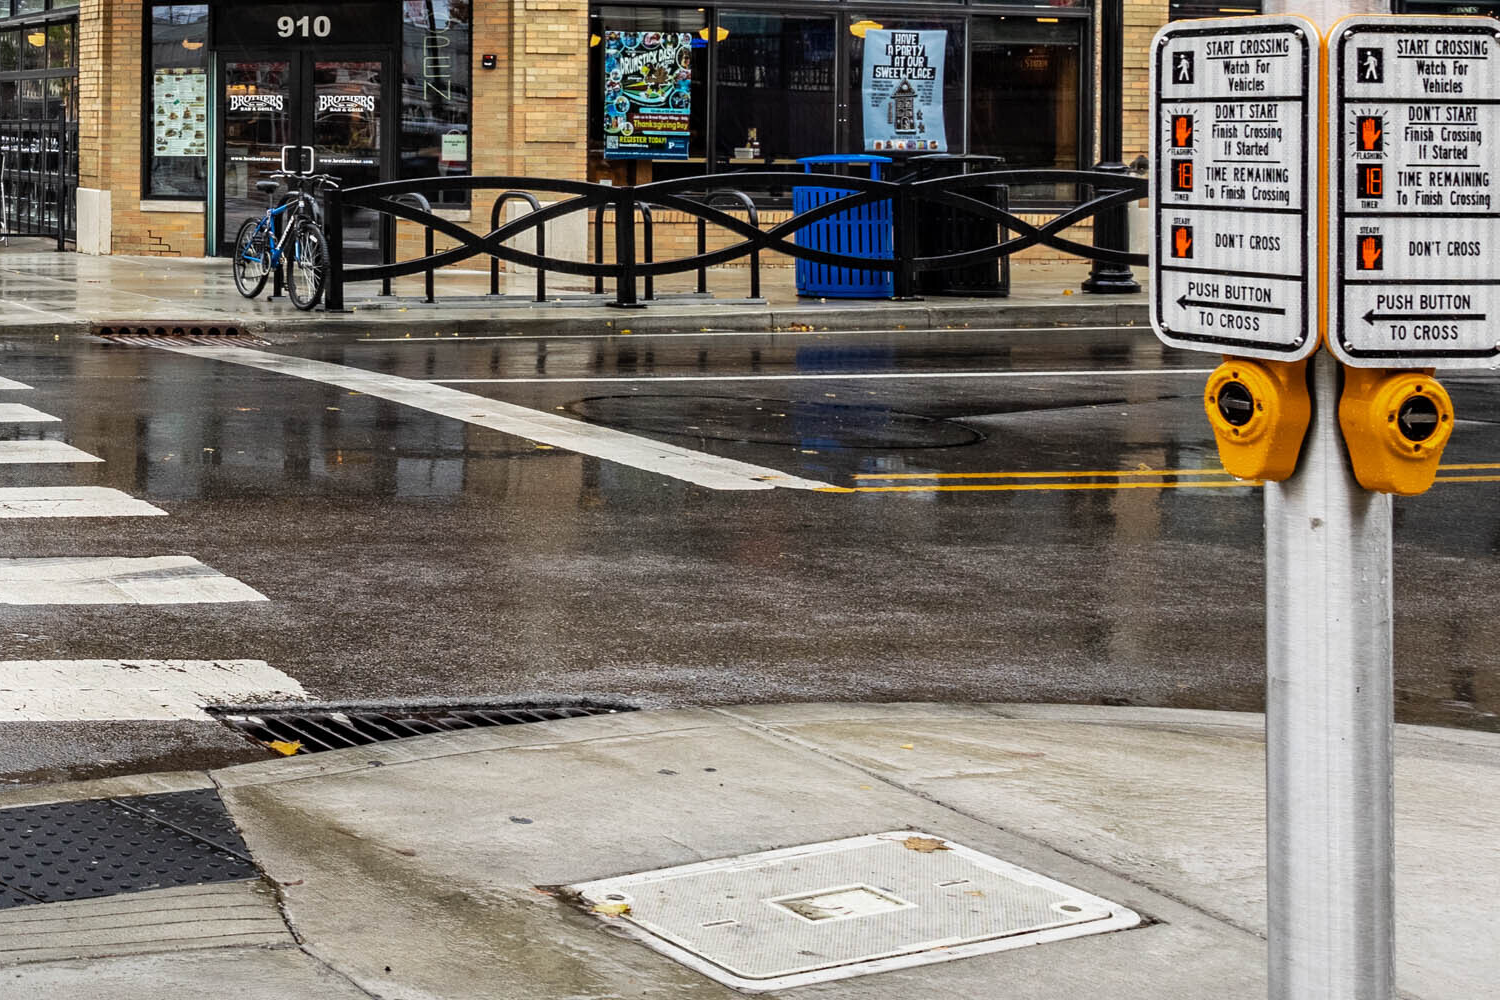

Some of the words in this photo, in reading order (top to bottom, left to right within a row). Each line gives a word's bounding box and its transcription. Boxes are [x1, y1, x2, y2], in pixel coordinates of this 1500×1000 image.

[277, 15, 331, 38] 910
[894, 33, 916, 45] HAVE
[1206, 40, 1234, 55] START
[1240, 38, 1289, 54] CROSSING
[887, 45, 894, 55] A
[895, 45, 924, 56] PARTY
[1397, 40, 1428, 54] START
[1435, 40, 1488, 55] CROSSING
[424, 12, 451, 101] OPEN
[620, 50, 658, 75] DRUMSTICK
[659, 48, 676, 62] DASH
[894, 56, 905, 67] AT
[906, 56, 925, 67] OUR
[875, 67, 904, 78] SWEET
[906, 68, 934, 79] PLACE.
[1223, 60, 1250, 74] Watch
[1256, 60, 1270, 74] For
[1417, 60, 1446, 75] Watch
[1453, 60, 1468, 75] For
[1228, 77, 1265, 91] Vehicles
[1423, 78, 1463, 93] Vehicles
[230, 95, 284, 111] BROTHERS
[319, 95, 375, 112] BROTHERS
[1215, 104, 1244, 119] DON'T
[1249, 104, 1278, 118] START
[1409, 106, 1440, 121] DON'T
[1446, 106, 1478, 120] START
[633, 119, 676, 130] Thanksgiving
[1212, 124, 1237, 138] Finish
[1244, 124, 1282, 142] Crossing
[1405, 126, 1433, 141] Finish
[1441, 127, 1482, 145] Crossing
[1224, 141, 1231, 155] If
[1236, 141, 1268, 156] Started
[1419, 145, 1427, 159] If
[1432, 145, 1468, 160] Started
[1179, 163, 1192, 188] 18
[1206, 167, 1227, 181] TIME
[1233, 168, 1289, 183] REMAINING
[1366, 168, 1382, 194] 18
[1397, 172, 1422, 186] TIME
[1429, 172, 1489, 187] REMAINING
[1205, 185, 1214, 199] To
[1221, 185, 1245, 200] Finish
[1252, 186, 1289, 206] Crossing
[1397, 191, 1407, 205] To
[1415, 191, 1443, 205] Finish
[1450, 191, 1490, 209] Crossing
[1215, 233, 1244, 248] DON'T
[1250, 235, 1280, 251] CROSS
[1409, 241, 1441, 256] DON'T
[1447, 241, 1480, 256] CROSS
[1188, 282, 1219, 298] PUSH
[1225, 285, 1271, 302] BUTTON
[1377, 295, 1413, 309] PUSH
[1420, 295, 1471, 309] BUTTON
[1200, 312, 1214, 326] TO
[1220, 314, 1260, 331] CROSS
[1390, 325, 1406, 340] TO
[1414, 325, 1458, 340] CROSS
